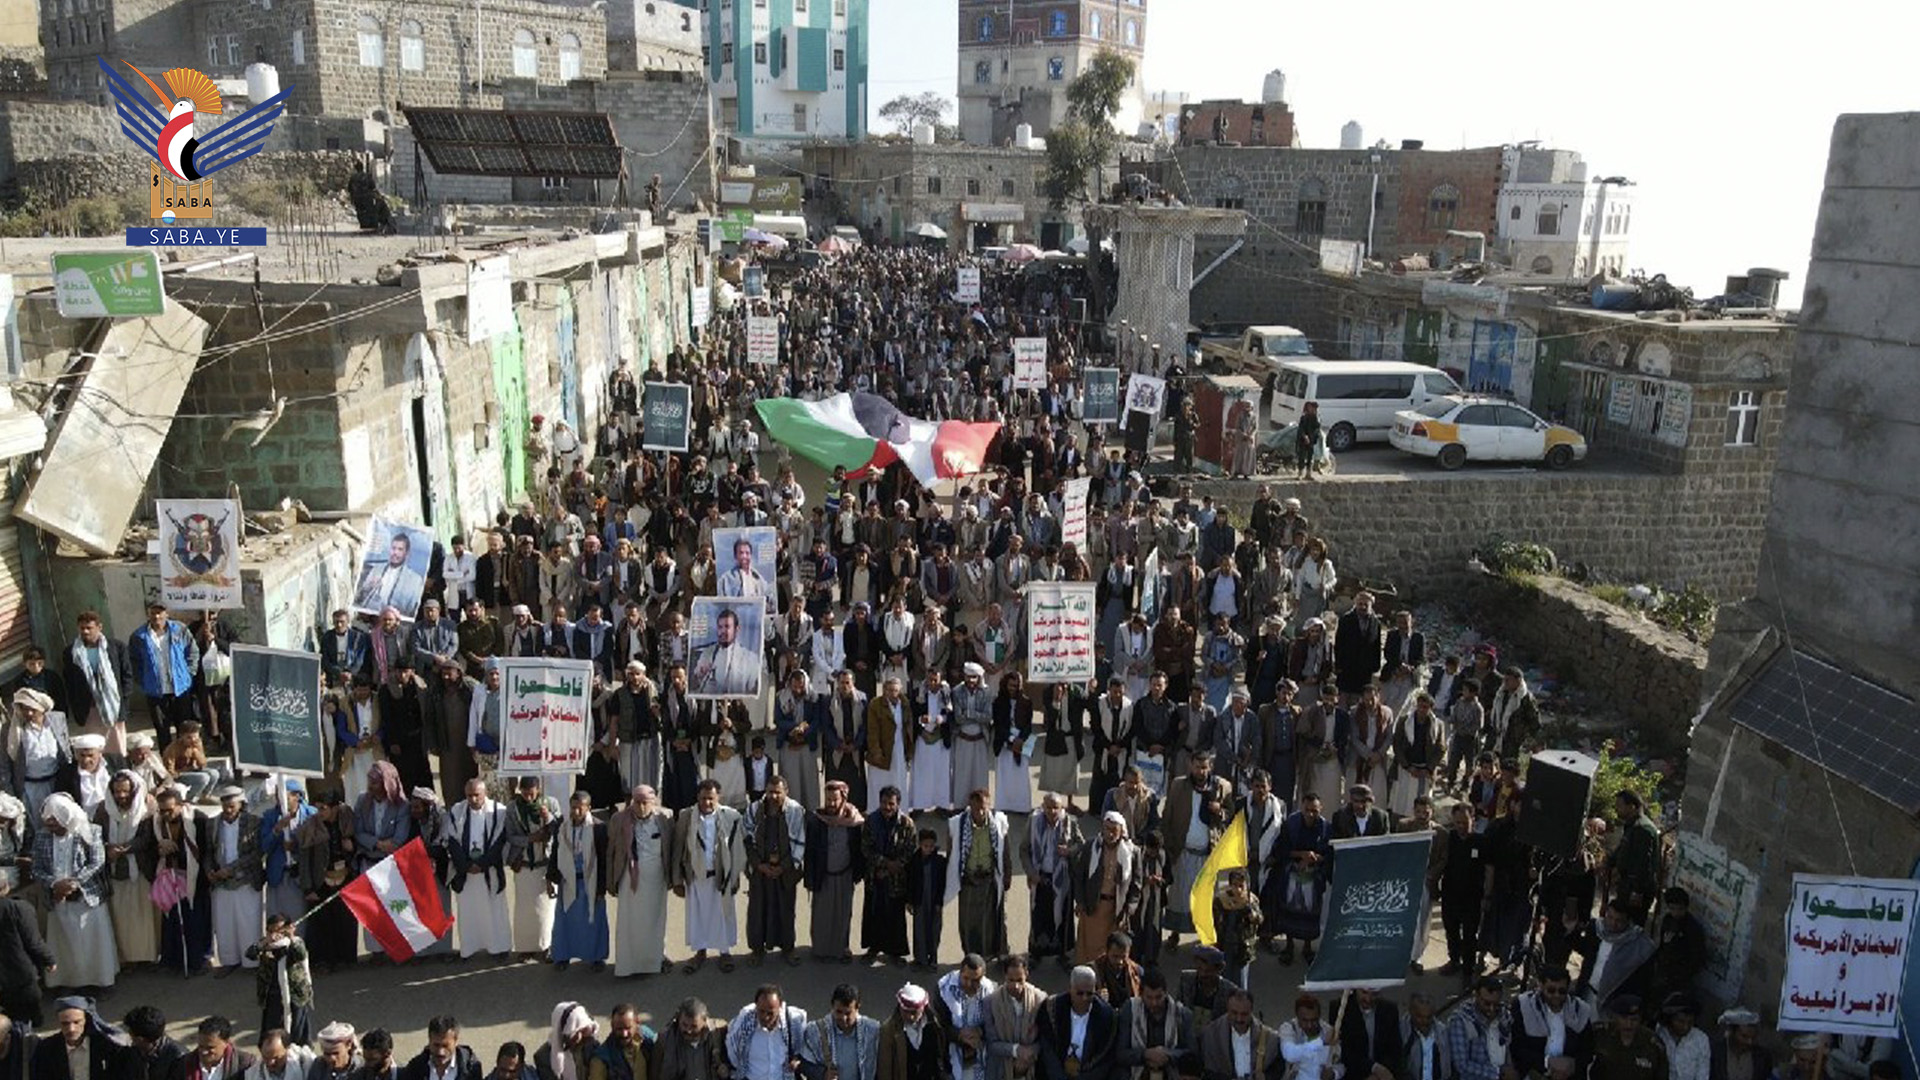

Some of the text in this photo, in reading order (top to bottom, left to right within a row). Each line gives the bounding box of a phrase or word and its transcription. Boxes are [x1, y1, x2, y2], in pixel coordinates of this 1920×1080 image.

[514, 674, 583, 698] قاطعوا
[1802, 890, 1904, 921] قاطعوا
[1793, 926, 1902, 959] البضائع الأمريكية
